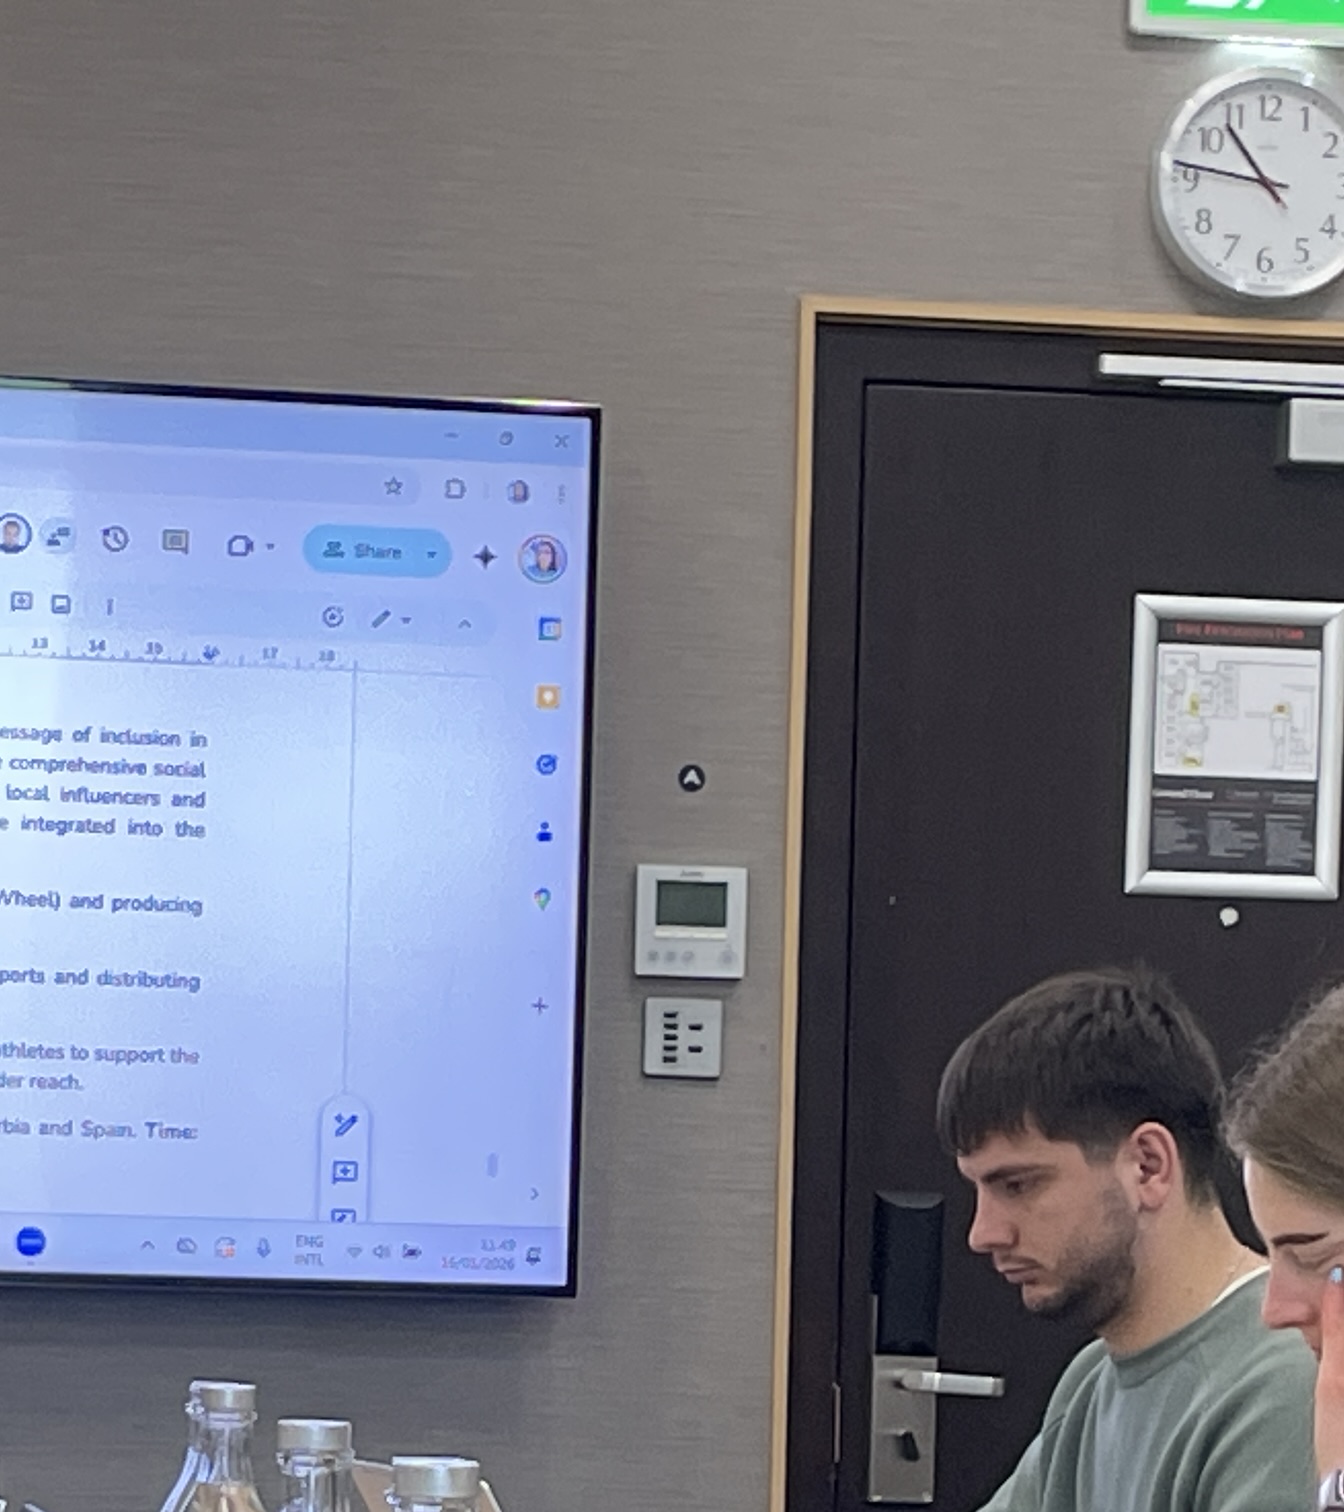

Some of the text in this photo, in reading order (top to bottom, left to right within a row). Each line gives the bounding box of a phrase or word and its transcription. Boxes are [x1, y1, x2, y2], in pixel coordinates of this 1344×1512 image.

[1225, 102, 1244, 130] 11
[1258, 95, 1283, 122] 12
[1301, 106, 1310, 132] 1
[1197, 126, 1225, 154] 10
[1322, 131, 1339, 159] 2
[1182, 165, 1201, 193] 9
[1194, 208, 1213, 235] 8
[1319, 214, 1338, 240] 4
[1223, 233, 1241, 262] 7
[1256, 246, 1274, 274] 6
[1293, 237, 1310, 264] 5
[354, 543, 403, 560] Share
[71, 726, 93, 743] of
[99, 727, 182, 747] inclusion
[189, 731, 208, 748] in
[8, 757, 148, 776] comprehensive
[153, 761, 207, 778] social
[5, 784, 51, 802] local
[59, 786, 162, 806] influencers
[170, 792, 207, 808] and
[20, 816, 117, 836] integrated
[127, 818, 164, 837] into
[174, 821, 207, 838] the
[68, 894, 105, 909] and
[110, 895, 203, 917] producing
[53, 968, 90, 985] and
[95, 970, 201, 993] distributing
[69, 1045, 90, 1061] to
[93, 1048, 166, 1068] support
[169, 1047, 201, 1064] the
[28, 1074, 84, 1090] reach.
